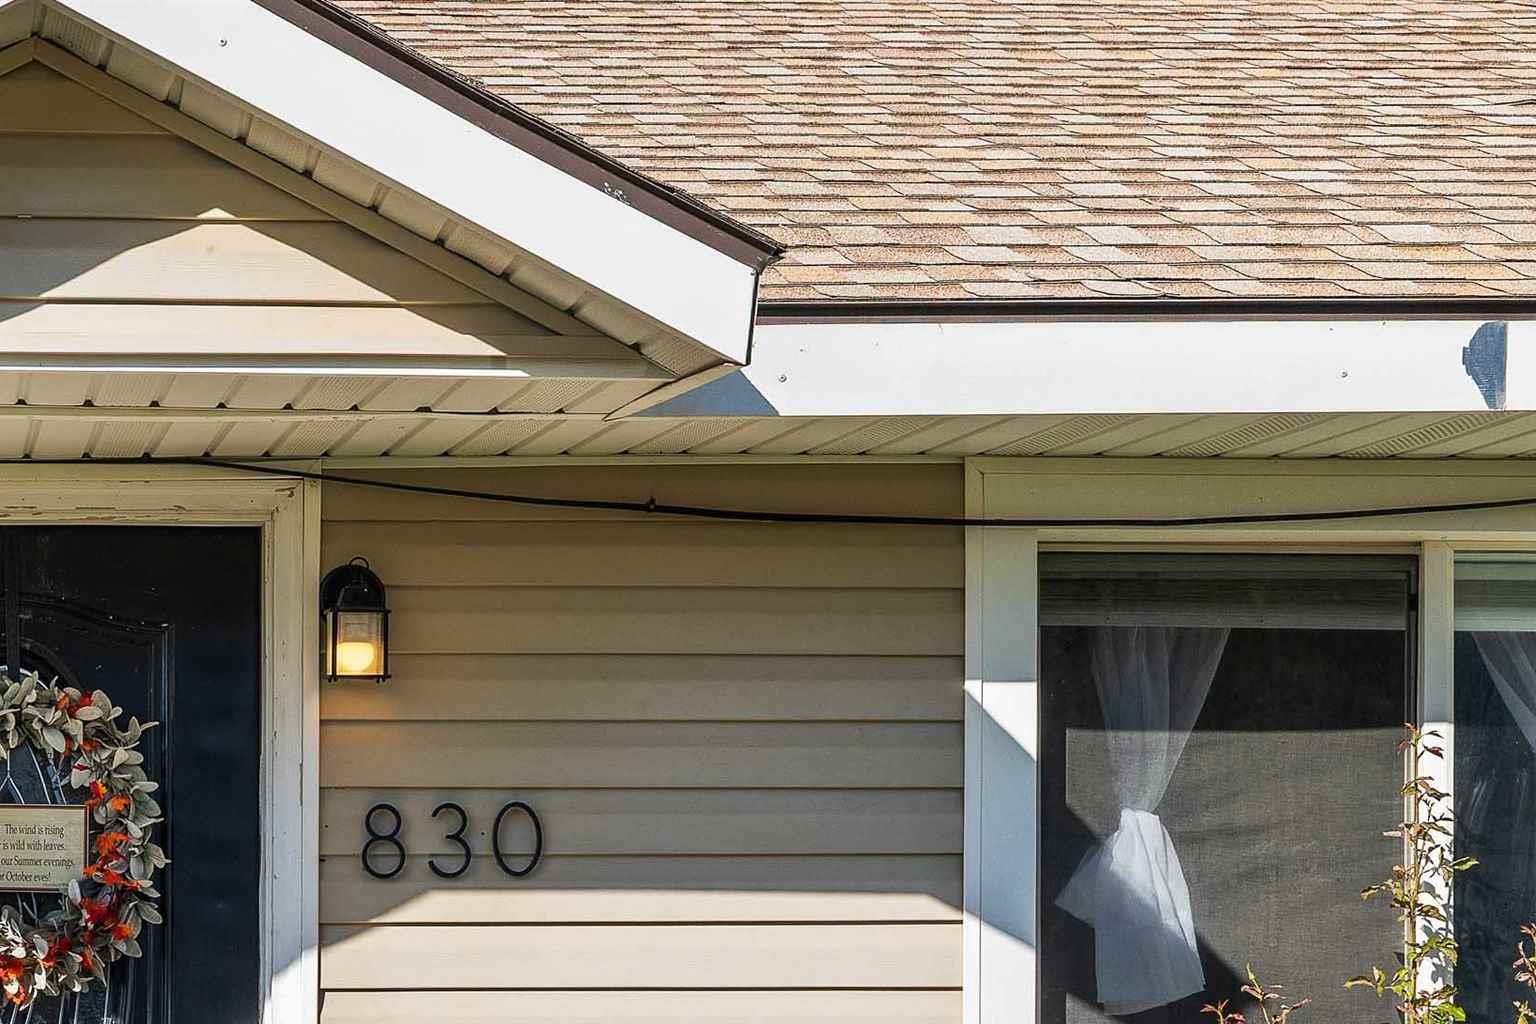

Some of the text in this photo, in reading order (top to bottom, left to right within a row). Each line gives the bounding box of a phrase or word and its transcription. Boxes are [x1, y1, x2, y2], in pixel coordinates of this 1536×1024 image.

[4, 823, 18, 834] The
[18, 824, 37, 834] wind
[9, 839, 25, 849] wild
[26, 840, 42, 849] with
[361, 801, 543, 879] 830
[0, 857, 13, 866] our
[14, 855, 42, 866] Summer
[6, 871, 33, 882] October
[34, 871, 51, 881] eves!
